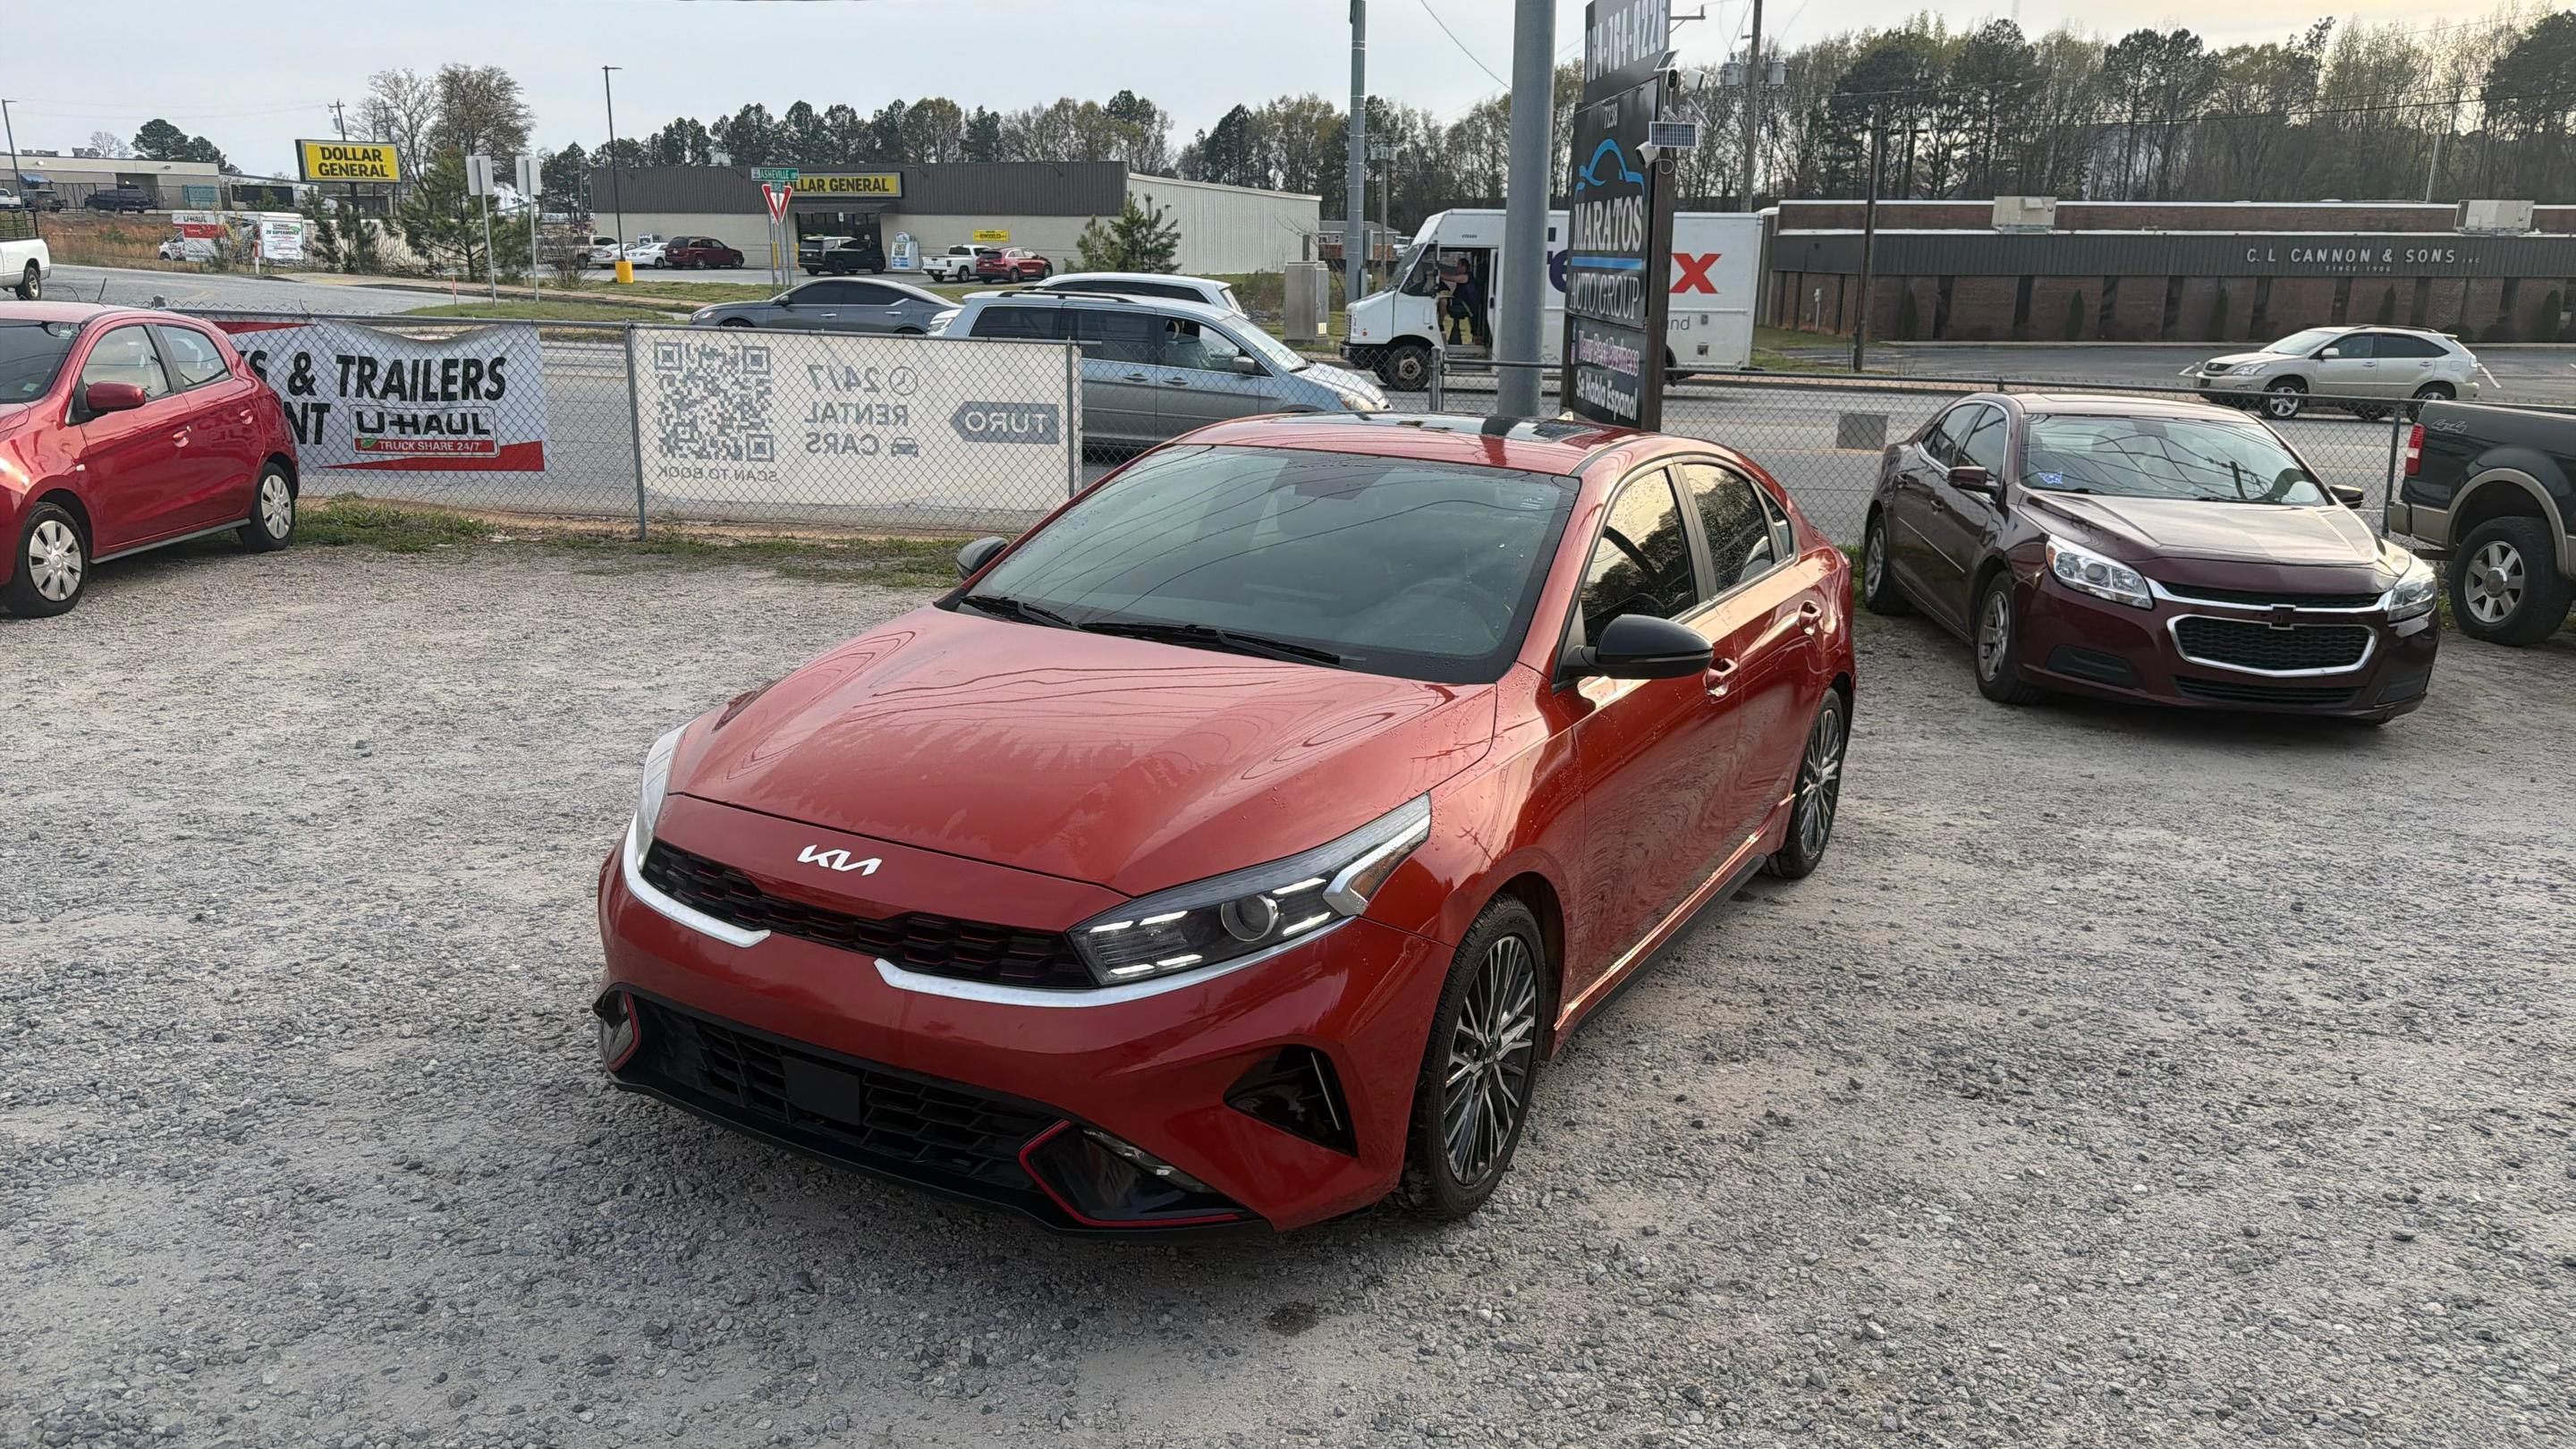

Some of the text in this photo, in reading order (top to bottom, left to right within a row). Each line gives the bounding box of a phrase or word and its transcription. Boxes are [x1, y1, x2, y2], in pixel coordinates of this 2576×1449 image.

[319, 146, 384, 162] DOLLAR
[318, 162, 389, 178] GENERAL
[760, 169, 789, 180] ASHEVILLE
[828, 178, 890, 192] GENERAL
[1572, 194, 1643, 252] MARATOS
[2246, 248, 2260, 262] C.
[2267, 248, 2276, 262] L
[2291, 249, 2371, 263] CANNON
[2382, 249, 2394, 263] &
[2404, 249, 2456, 264] SONS
[1569, 271, 1640, 320] AUTO GROUP
[287, 351, 317, 397] &
[336, 354, 507, 402] TRAILERS
[1576, 369, 1639, 421] Se Habla Espanol
[355, 411, 491, 436] U-HAUL
[378, 440, 480, 452] TRUCK SHARE 24/7
[796, 843, 883, 877] KIA
